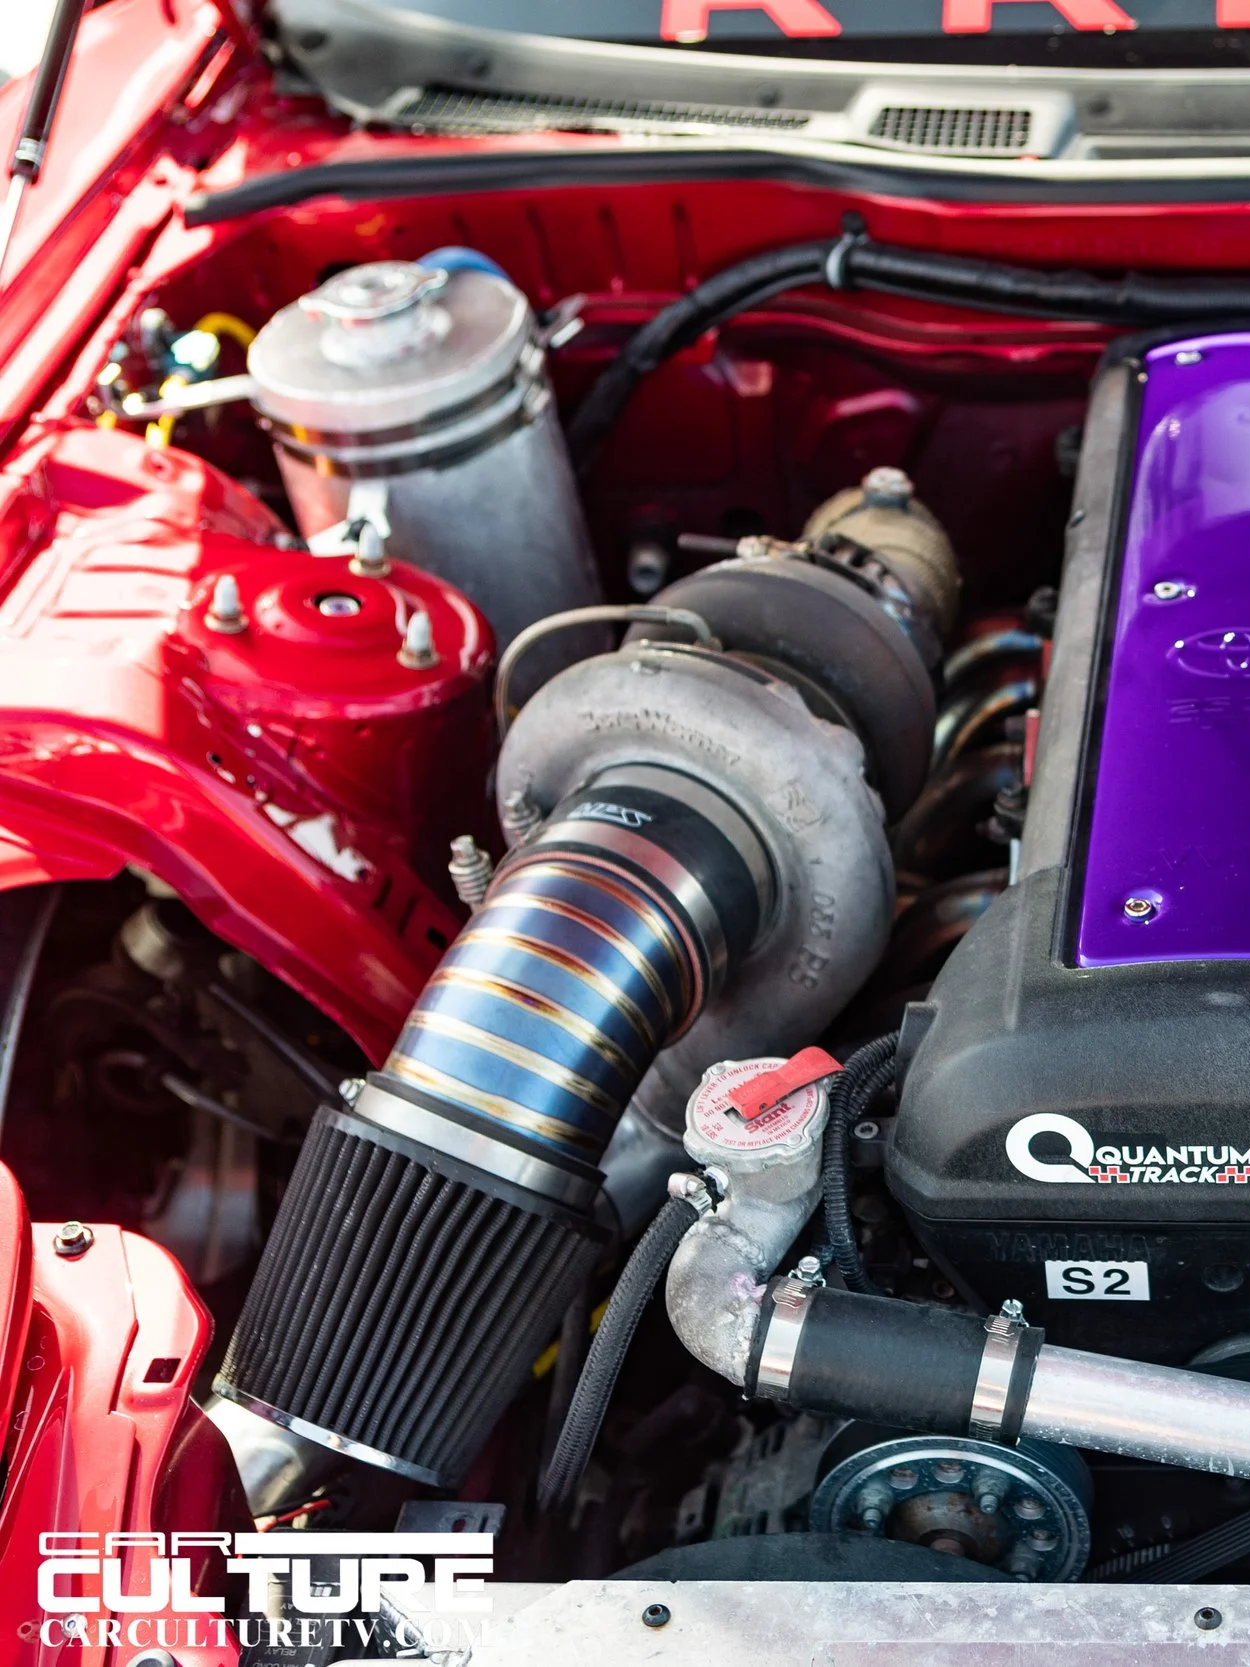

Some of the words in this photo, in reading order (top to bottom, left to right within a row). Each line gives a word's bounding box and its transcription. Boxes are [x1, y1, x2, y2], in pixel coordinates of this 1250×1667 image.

[727, 1063, 761, 1077] UNLOCK
[744, 1102, 791, 1134] Stant
[1128, 1166, 1218, 1183] TRACK
[1062, 1267, 1131, 1295] S2
